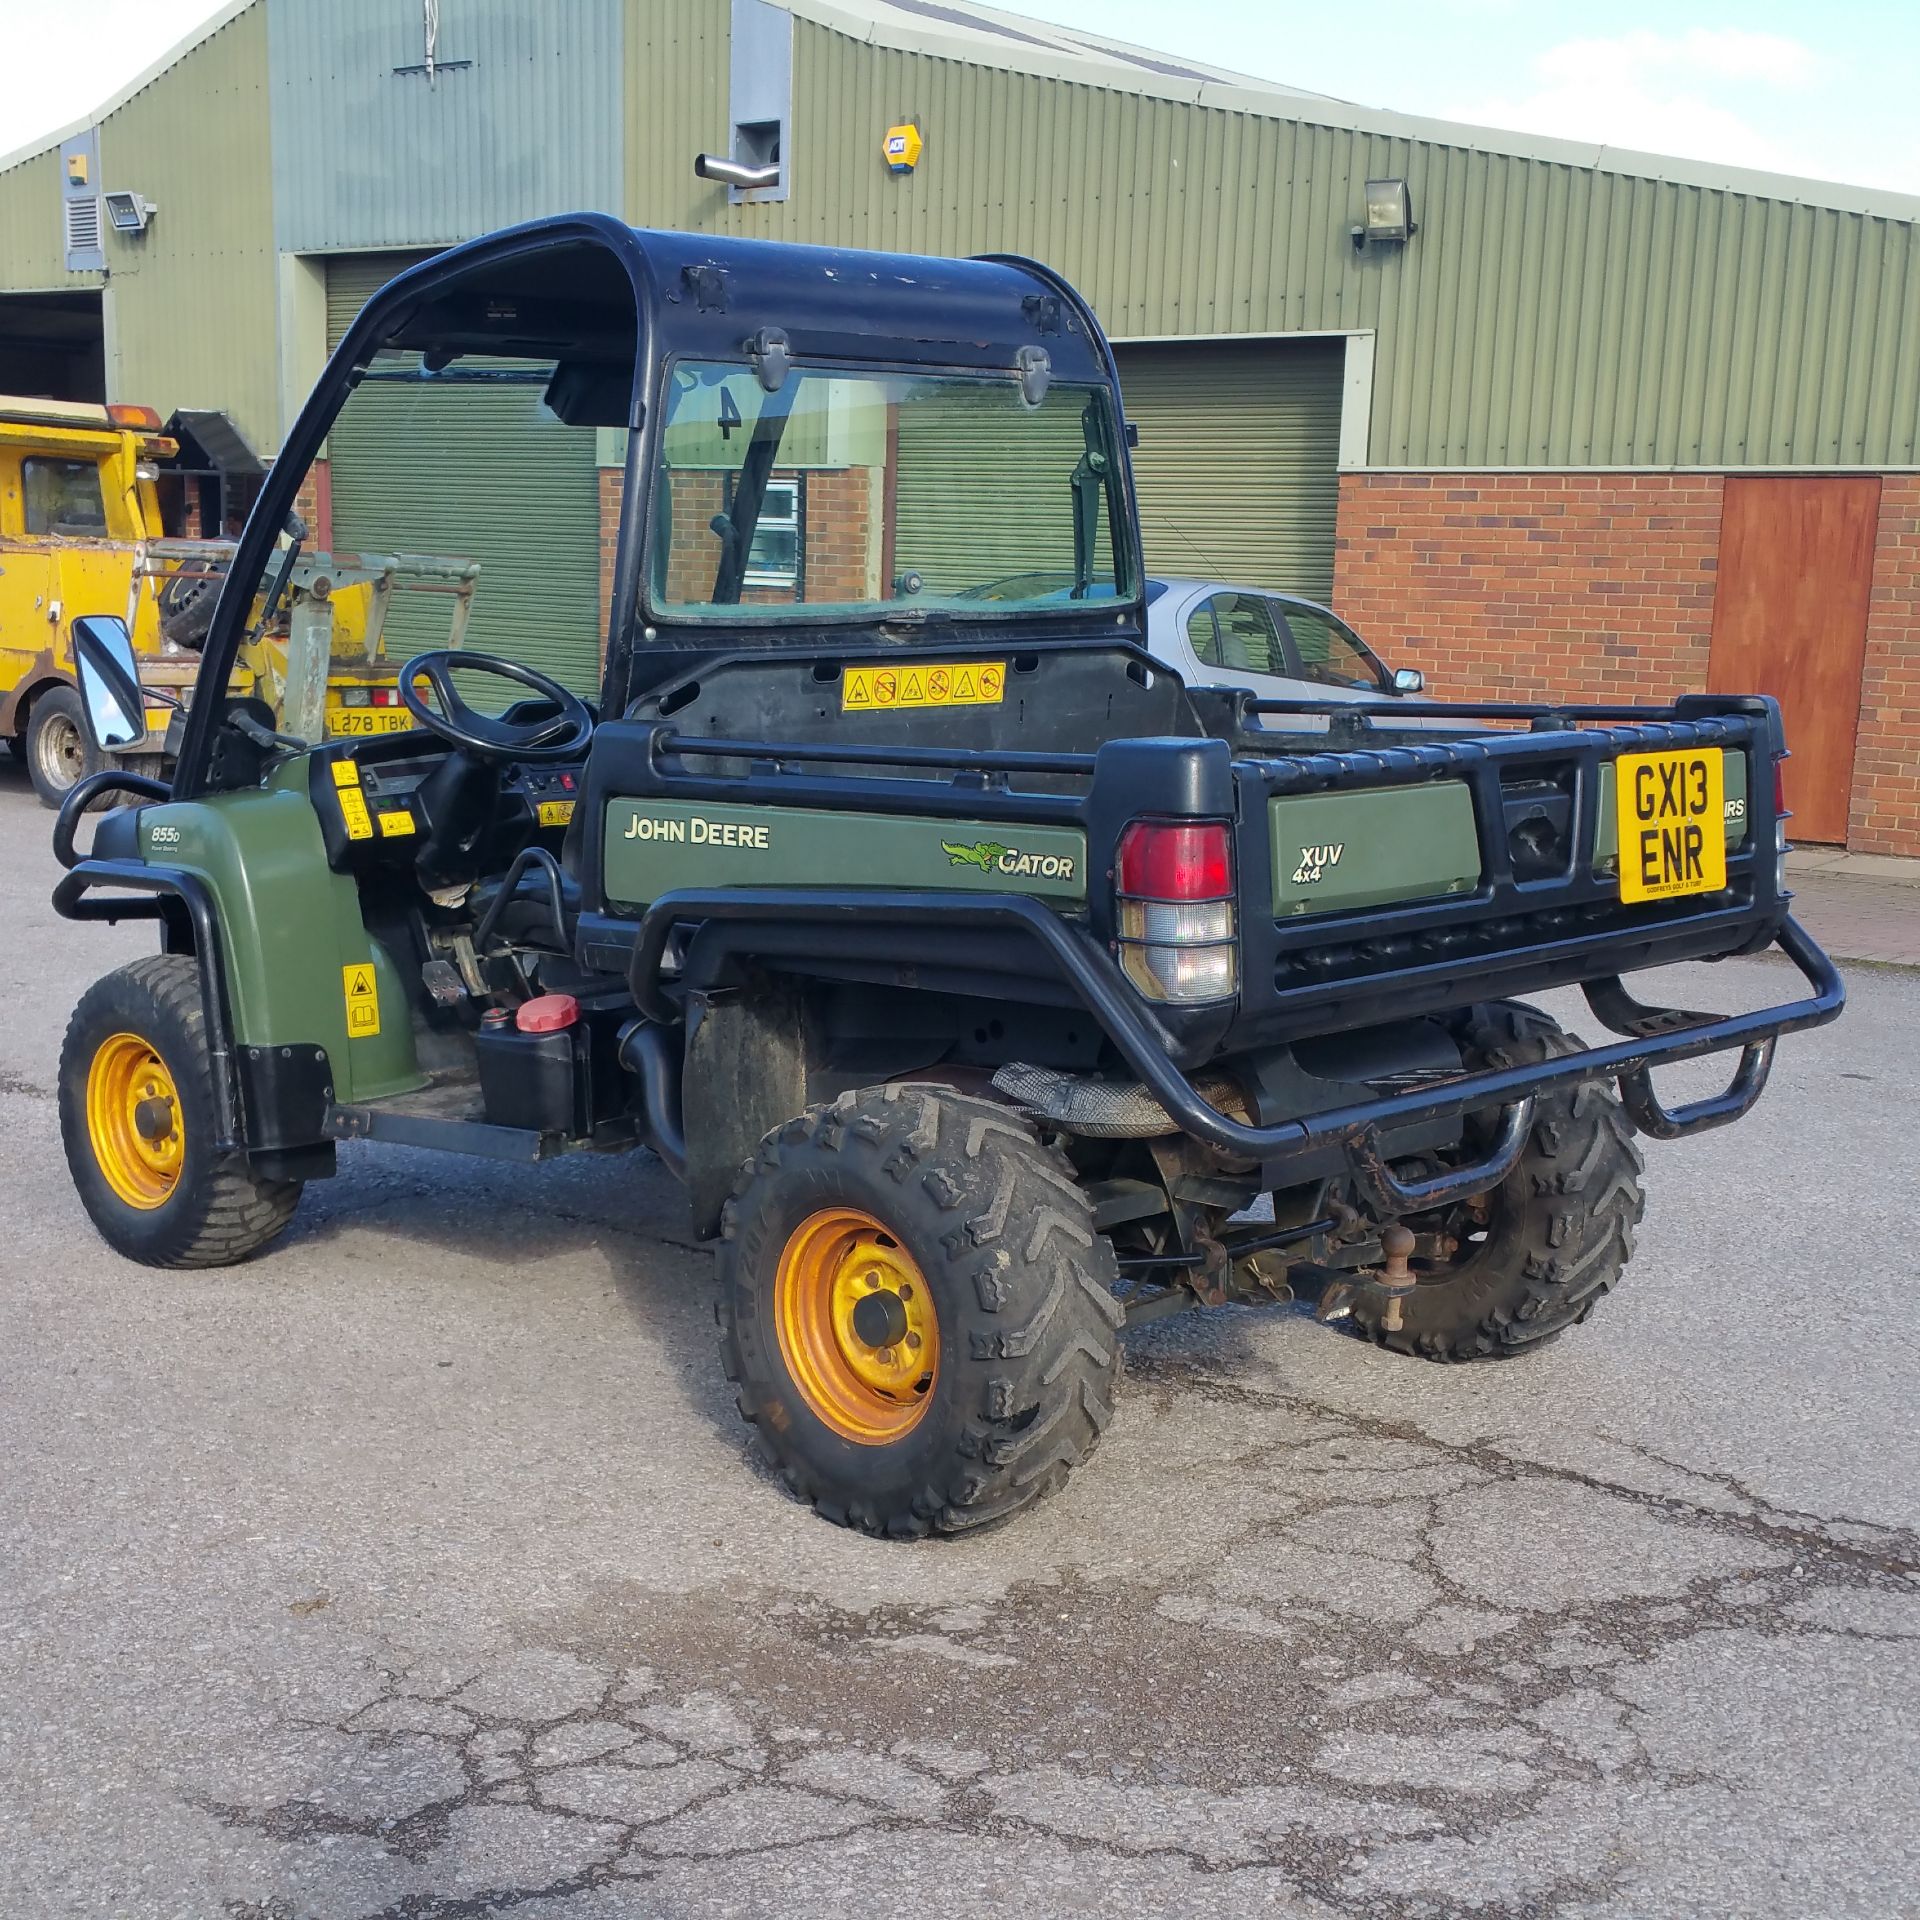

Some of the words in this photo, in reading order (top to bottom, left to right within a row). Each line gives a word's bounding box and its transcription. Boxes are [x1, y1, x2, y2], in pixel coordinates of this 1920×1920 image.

[889, 138, 905, 151] ADT
[331, 715, 373, 733] L278
[379, 715, 409, 731] TBK
[1635, 760, 1708, 821] GX13
[624, 813, 685, 843] JOHN
[690, 817, 769, 850] DEERE
[998, 848, 1075, 880] GATOR
[1300, 843, 1344, 868] XUV
[1640, 824, 1704, 887] ENR
[1291, 866, 1322, 885] 4x4
